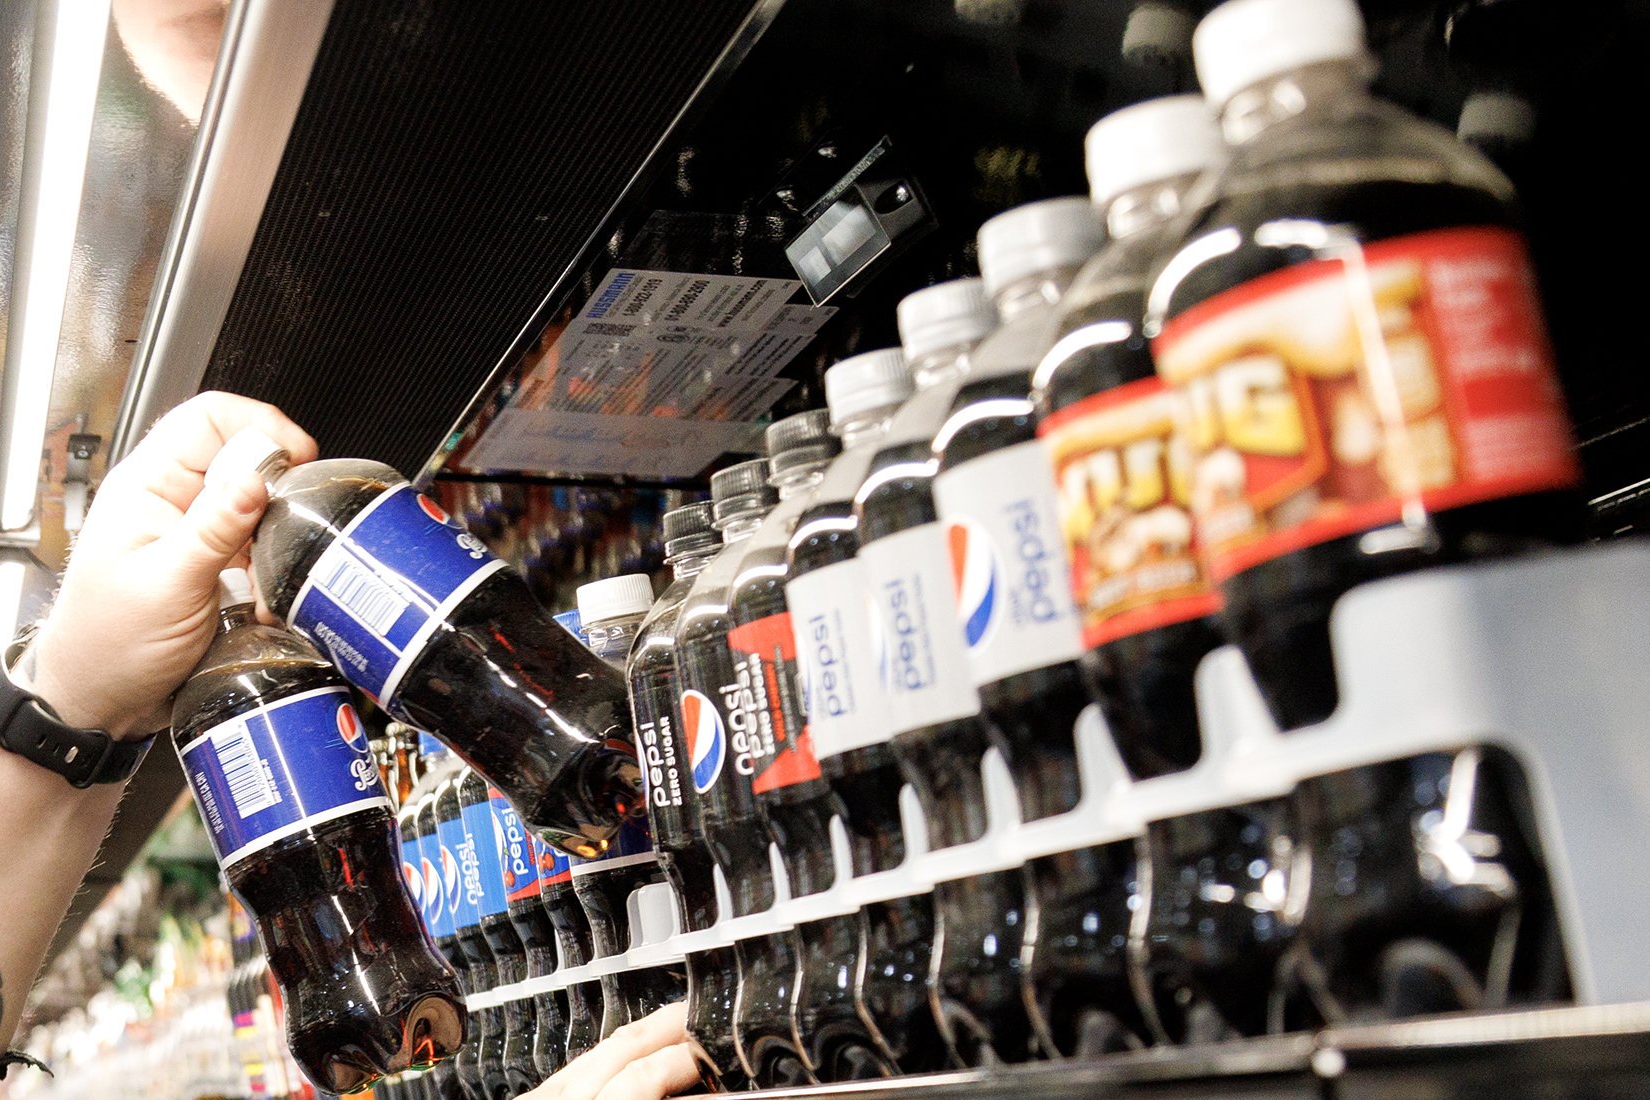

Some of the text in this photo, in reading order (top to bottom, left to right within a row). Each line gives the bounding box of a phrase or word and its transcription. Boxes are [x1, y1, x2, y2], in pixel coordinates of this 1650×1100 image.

[586, 272, 635, 318] HUSSMANN
[809, 614, 847, 717] pepsi
[884, 579, 926, 690] pepsi
[639, 721, 671, 807] pepsi
[659, 716, 683, 806] ZERO SUGAR
[501, 807, 529, 875] pepsi
